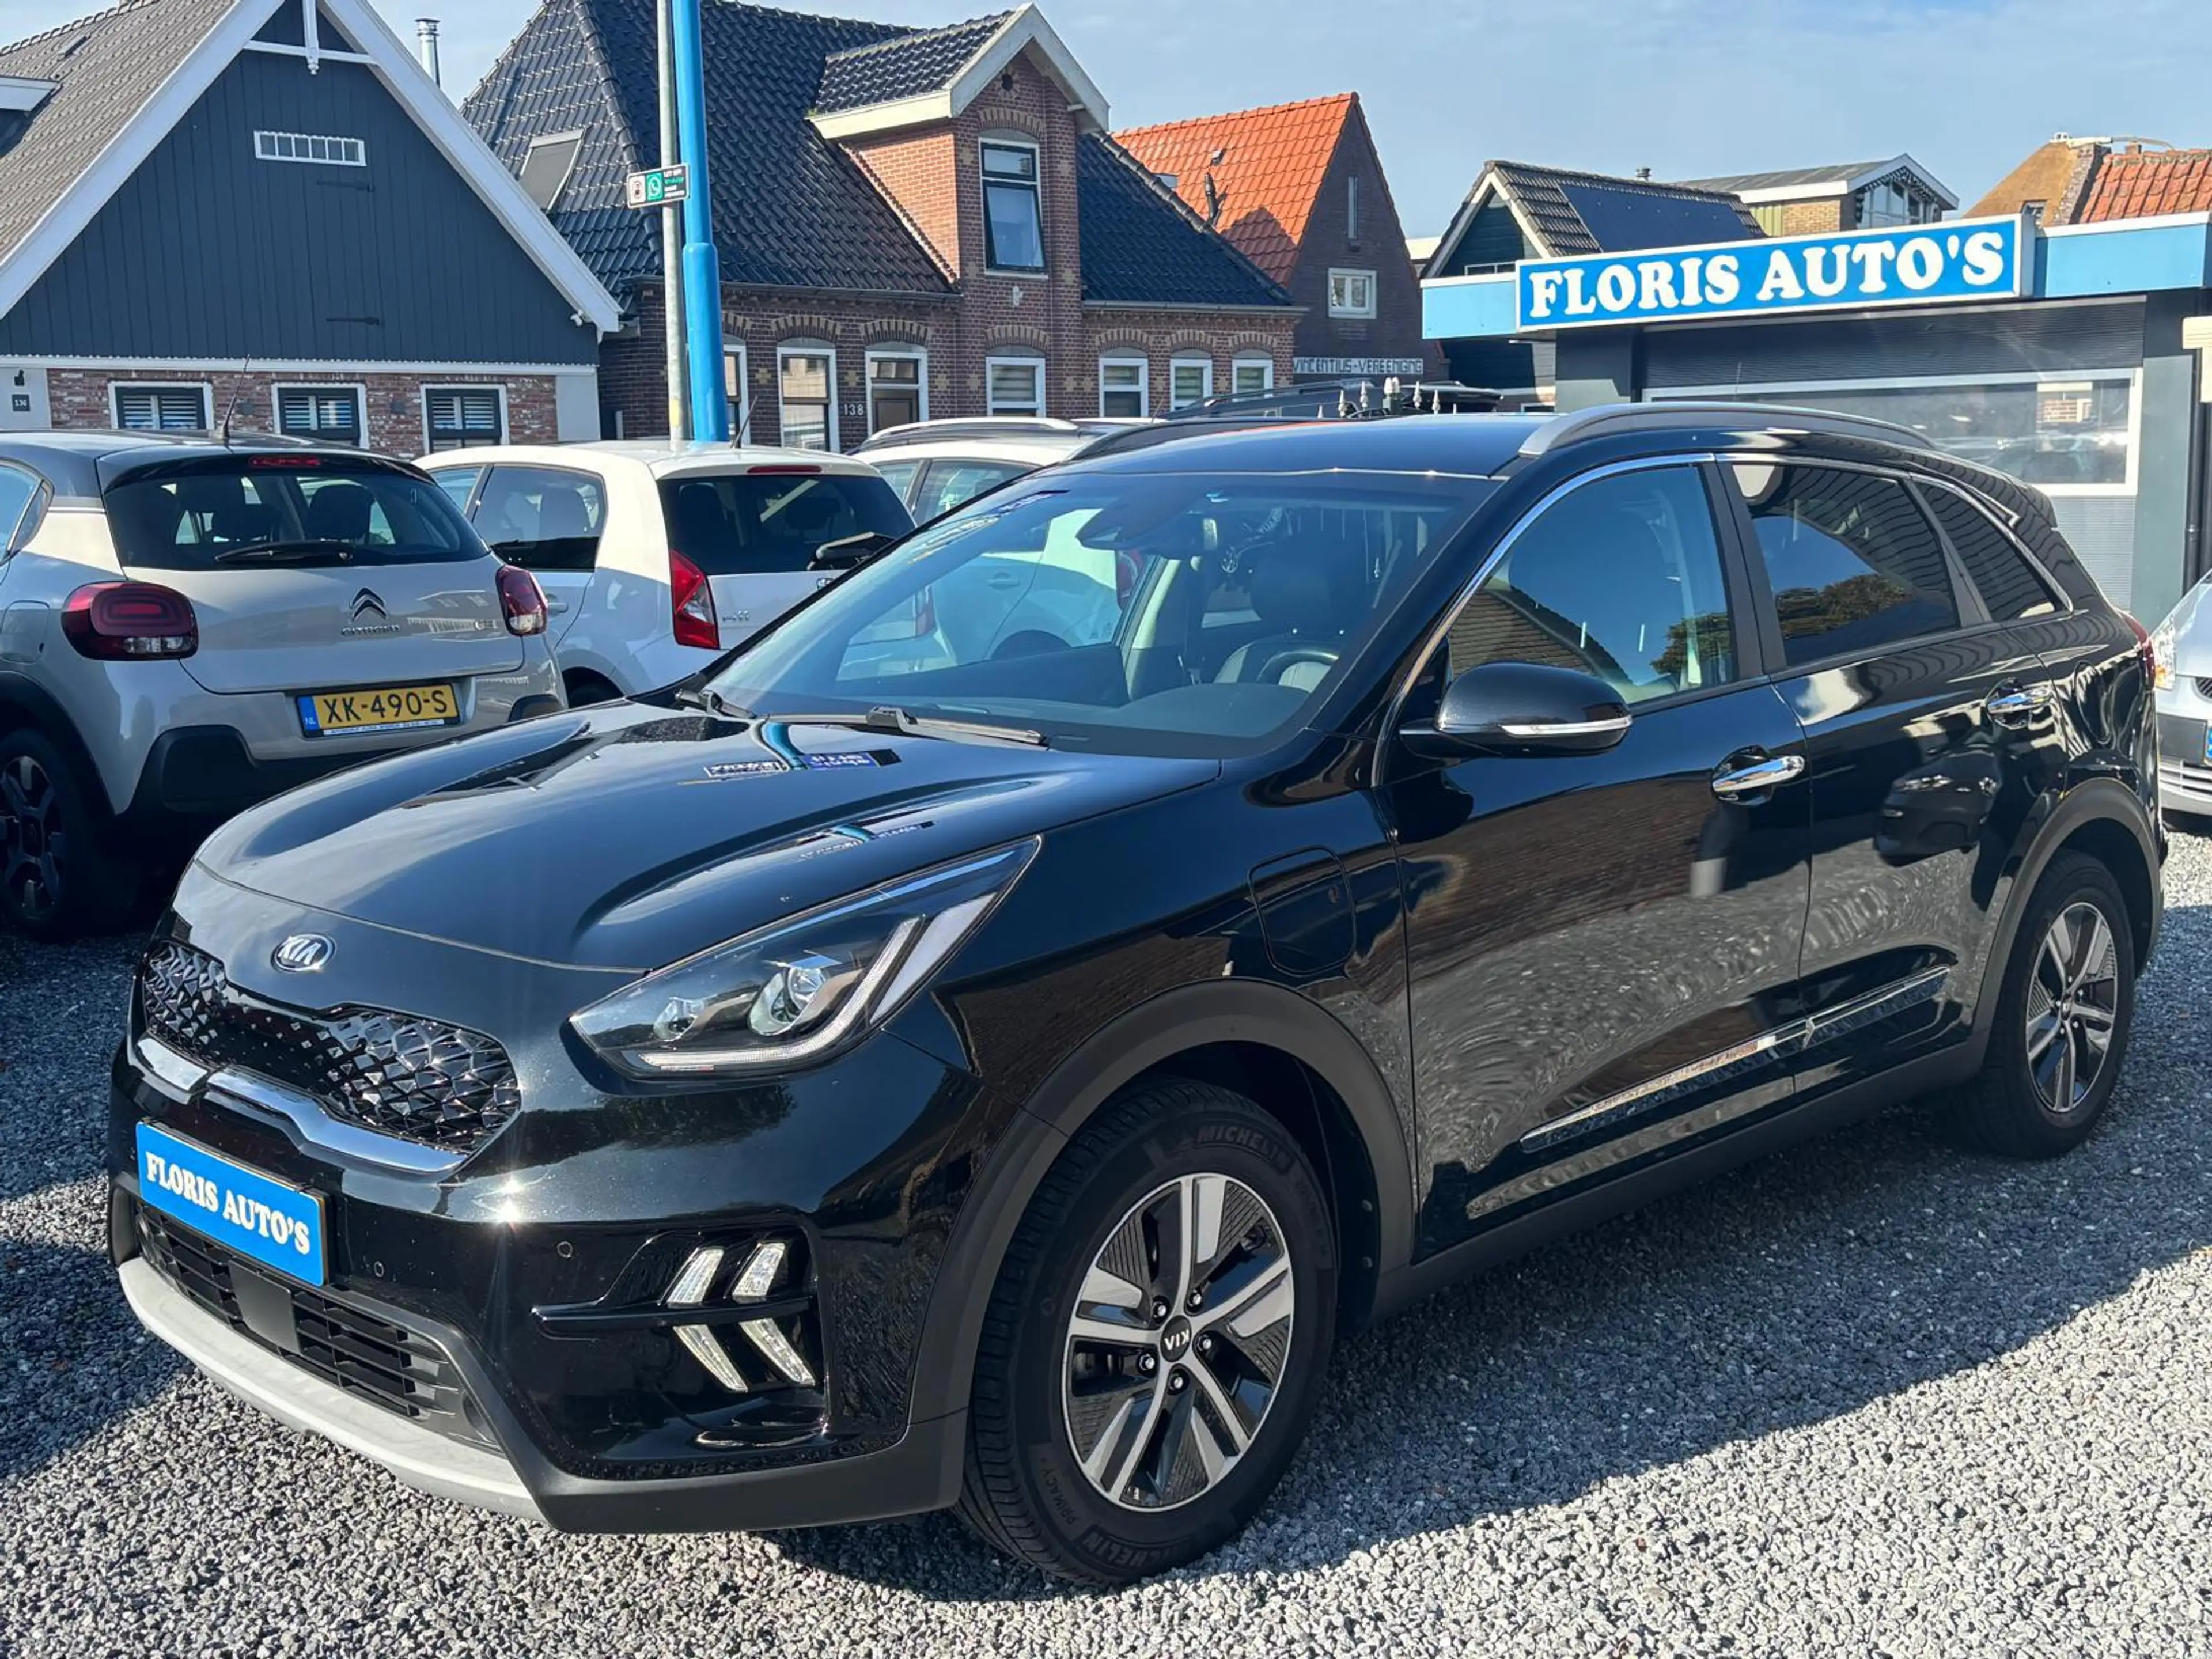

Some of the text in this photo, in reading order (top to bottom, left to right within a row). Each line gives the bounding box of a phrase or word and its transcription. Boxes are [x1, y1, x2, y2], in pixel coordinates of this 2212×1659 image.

[1529, 231, 2005, 319] FLORIS AUTO'S
[844, 403, 864, 415] 138
[323, 690, 448, 724] XK-490-S
[278, 938, 321, 965] KIA
[1196, 1125, 1293, 1171] MICHELIN
[145, 1151, 311, 1256] FLORIS AUTO'S
[1164, 1328, 1190, 1350] KIA
